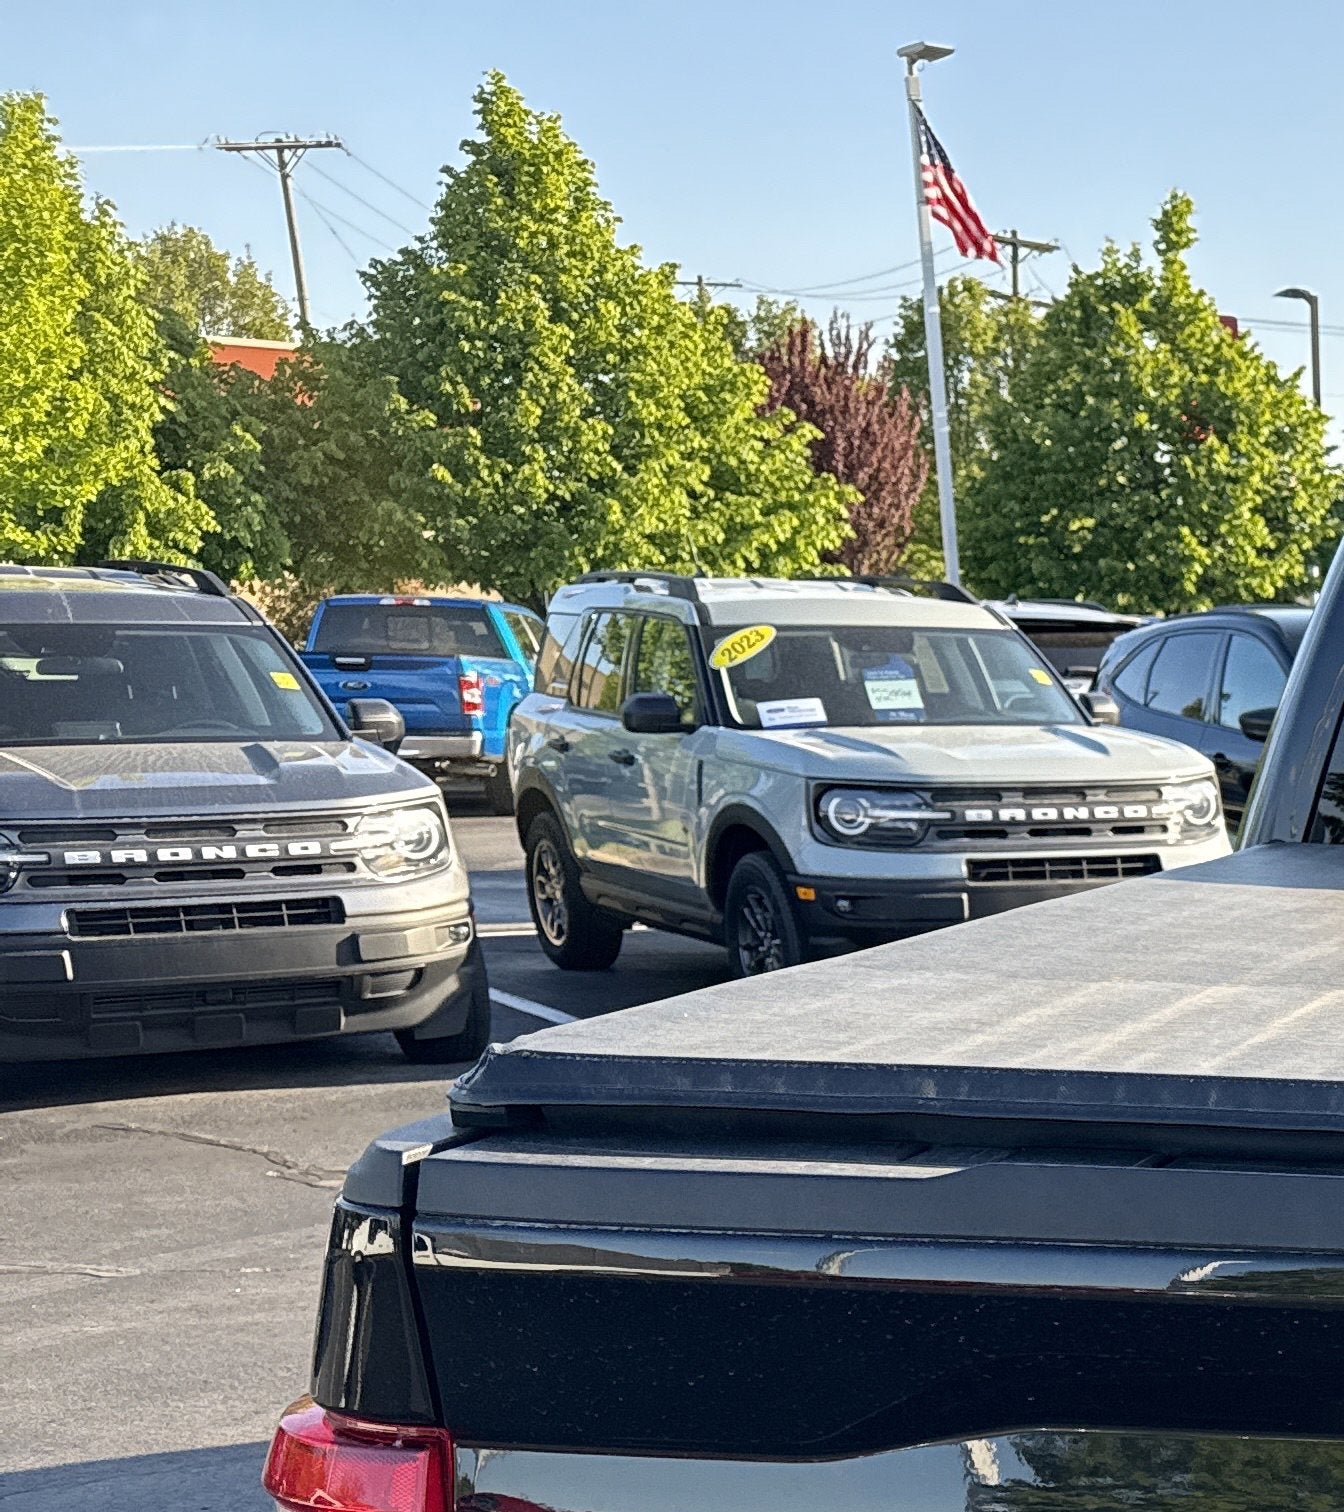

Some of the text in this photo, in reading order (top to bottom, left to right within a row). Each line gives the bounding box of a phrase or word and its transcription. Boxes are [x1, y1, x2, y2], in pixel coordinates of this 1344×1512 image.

[720, 629, 765, 663] 2023
[964, 804, 1148, 822] BRONCO
[64, 842, 322, 865] BRONCO
